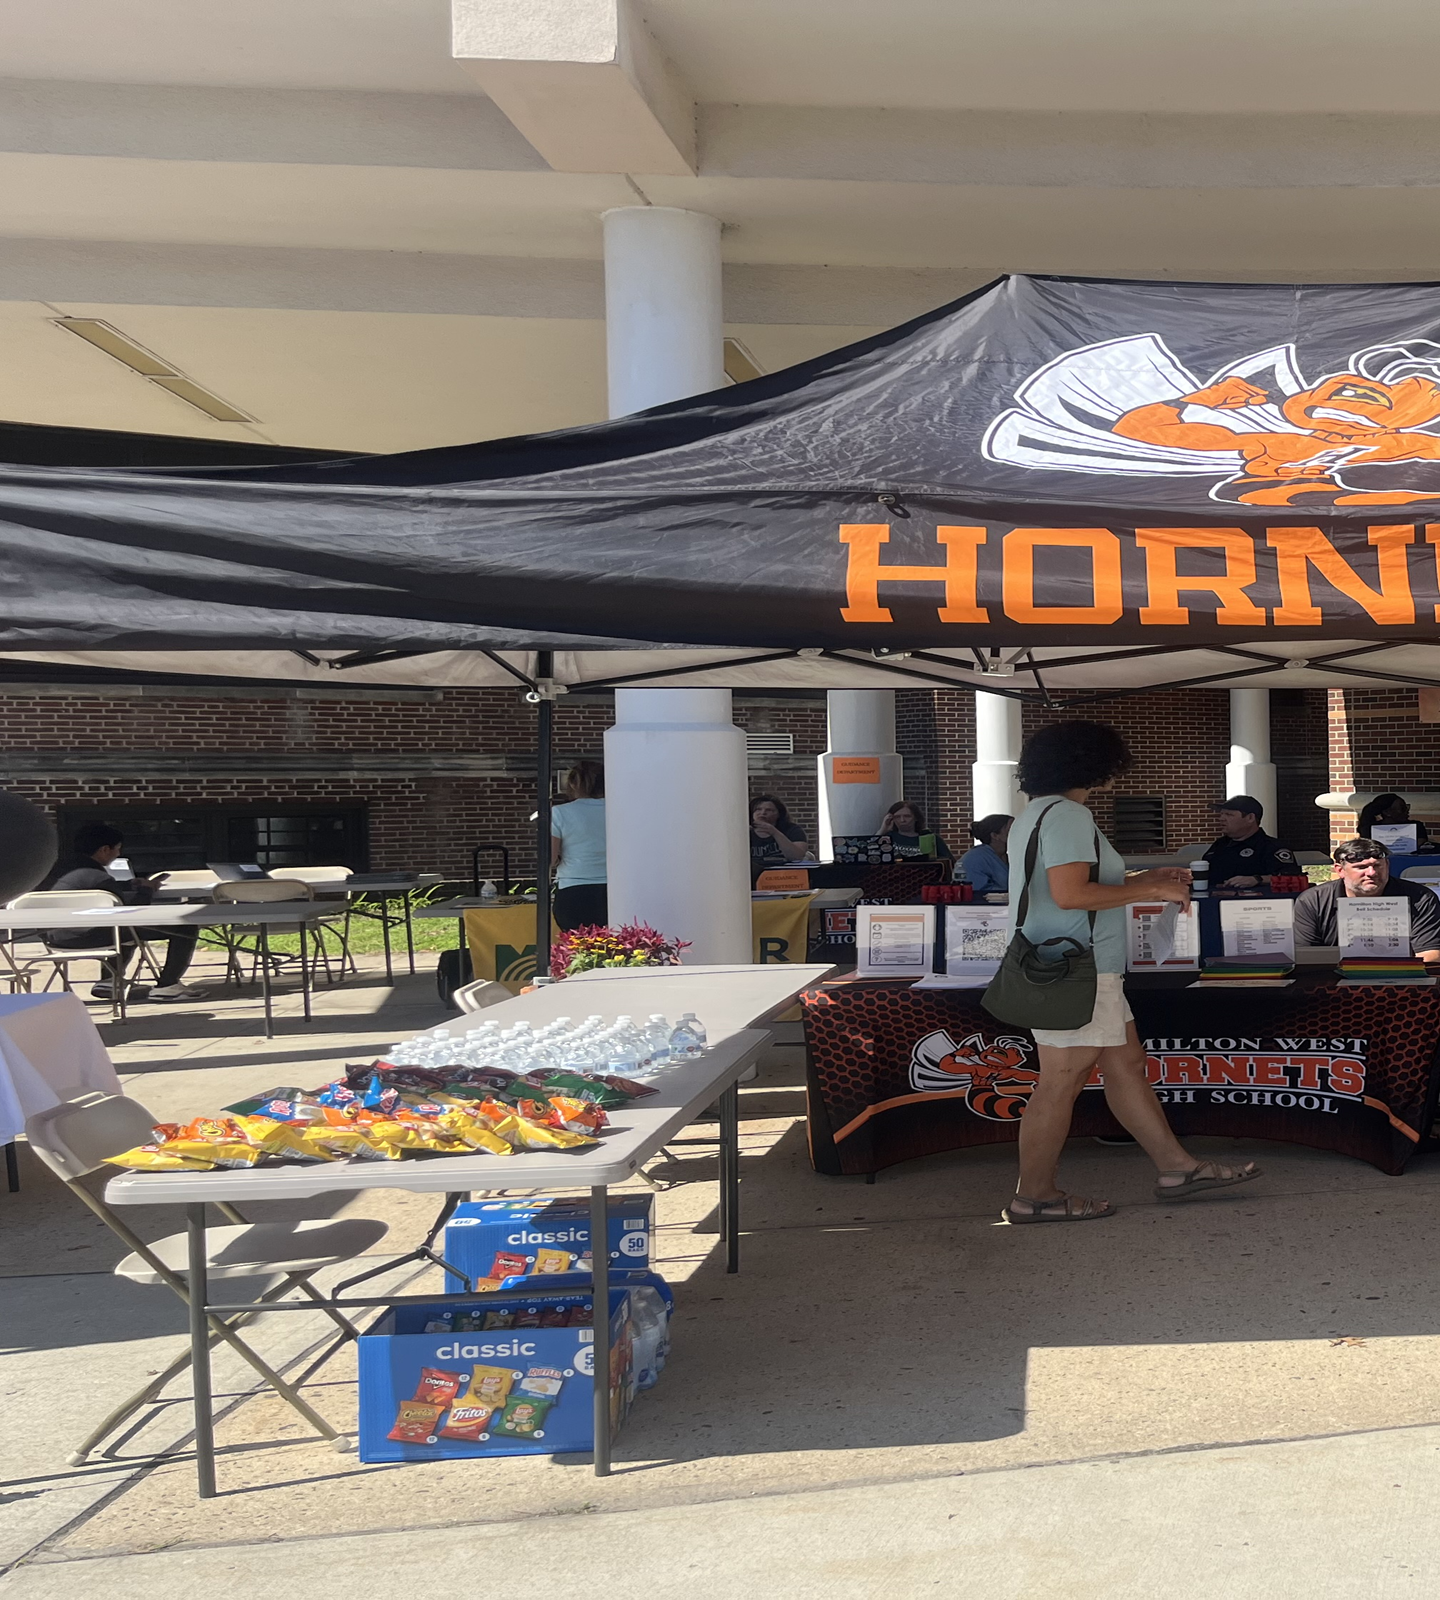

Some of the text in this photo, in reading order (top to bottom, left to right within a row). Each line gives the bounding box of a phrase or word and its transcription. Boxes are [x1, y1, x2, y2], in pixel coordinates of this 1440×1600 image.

[1141, 1038, 1368, 1053] MILTON WEST
[1146, 1055, 1367, 1096] RNETS
[1159, 1090, 1339, 1114] GH SCHOOL
[507, 1227, 589, 1246] classic
[628, 1238, 644, 1248] 50
[498, 1258, 522, 1268] Doritos
[436, 1339, 536, 1360] classic
[584, 1353, 594, 1366] 5
[528, 1367, 562, 1379] RUFFLES
[424, 1377, 454, 1388] Doritos
[484, 1376, 500, 1384] Lay's
[452, 1406, 487, 1421] Fritos
[514, 1406, 533, 1415] Lay's
